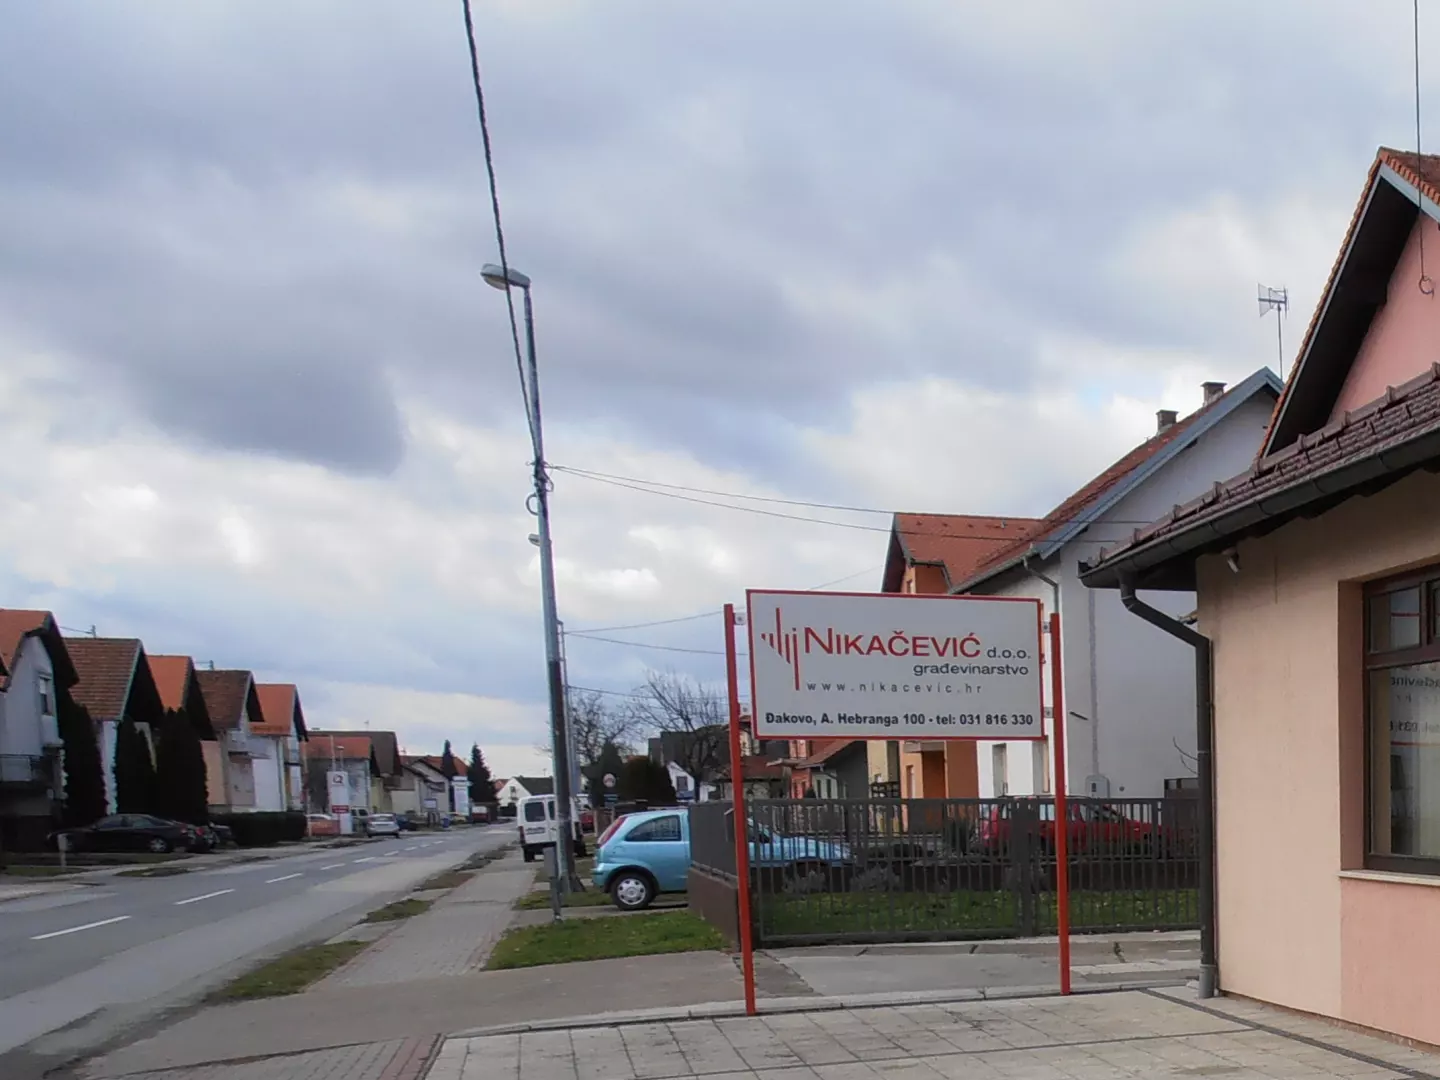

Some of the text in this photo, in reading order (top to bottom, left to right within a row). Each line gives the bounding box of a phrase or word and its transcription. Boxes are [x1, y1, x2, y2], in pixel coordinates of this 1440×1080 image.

[804, 627, 1031, 660] NIKAČEVIĆ d.o.o.
[913, 662, 1029, 677] građevinarstvo
[807, 681, 982, 694] www.nikacevic.hr
[765, 712, 1034, 727] Đakovo, A. Hebranga 100 tel: 031 816 330
